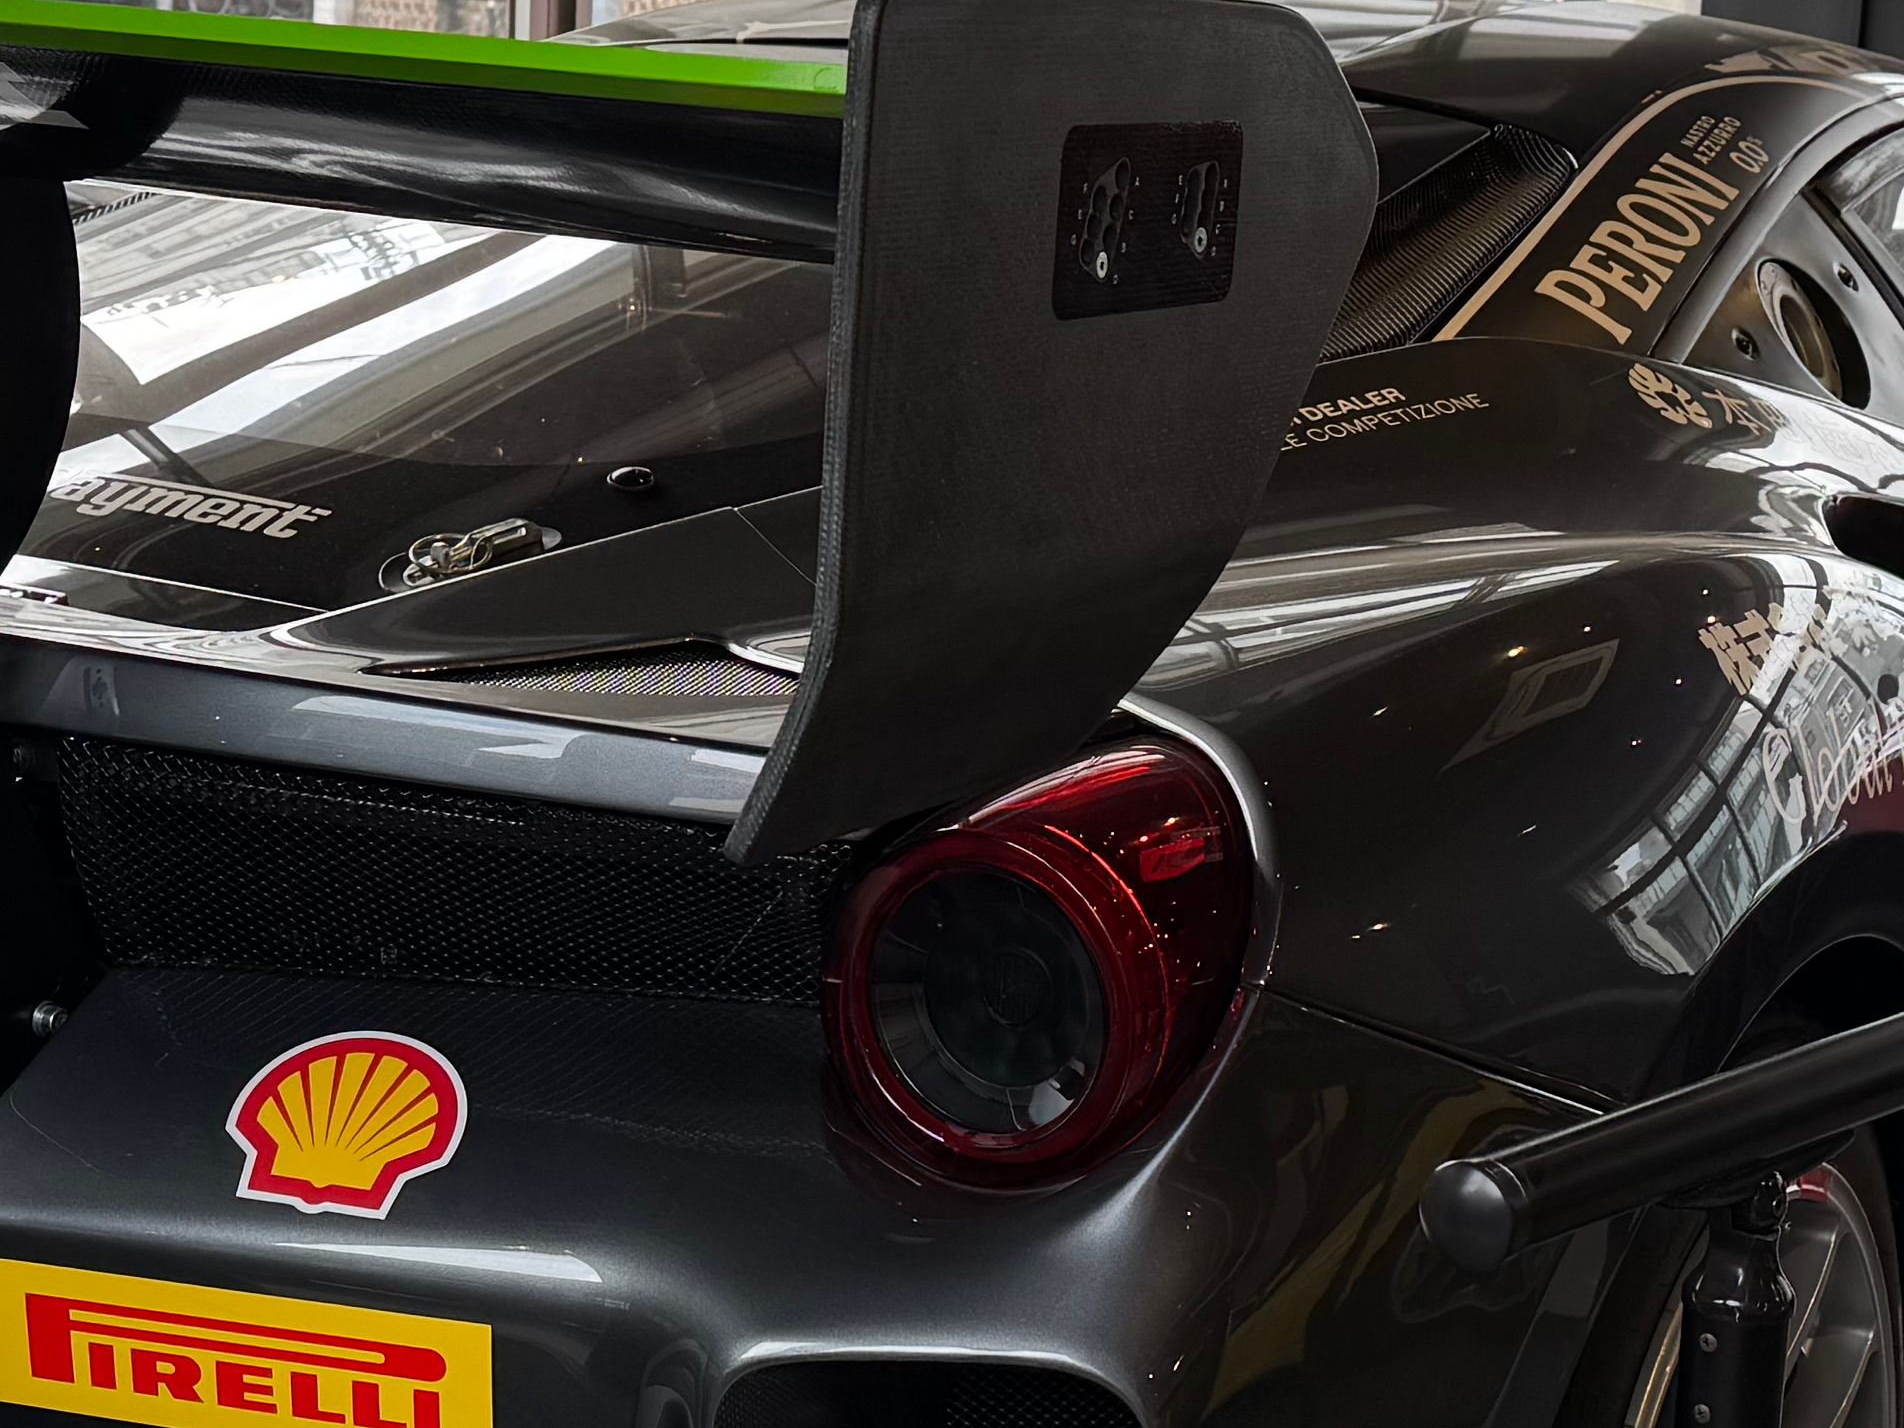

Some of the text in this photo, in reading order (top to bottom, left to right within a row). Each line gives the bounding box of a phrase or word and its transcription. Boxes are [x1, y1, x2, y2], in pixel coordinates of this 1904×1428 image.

[1680, 115, 1716, 149] NASTRO
[1692, 116, 1741, 165] AZZURRO
[1534, 152, 1739, 345] PERONI
[1298, 387, 1407, 422] DEALER
[1306, 393, 1490, 443] COMPETIZIONE
[50, 472, 333, 540] ayment
